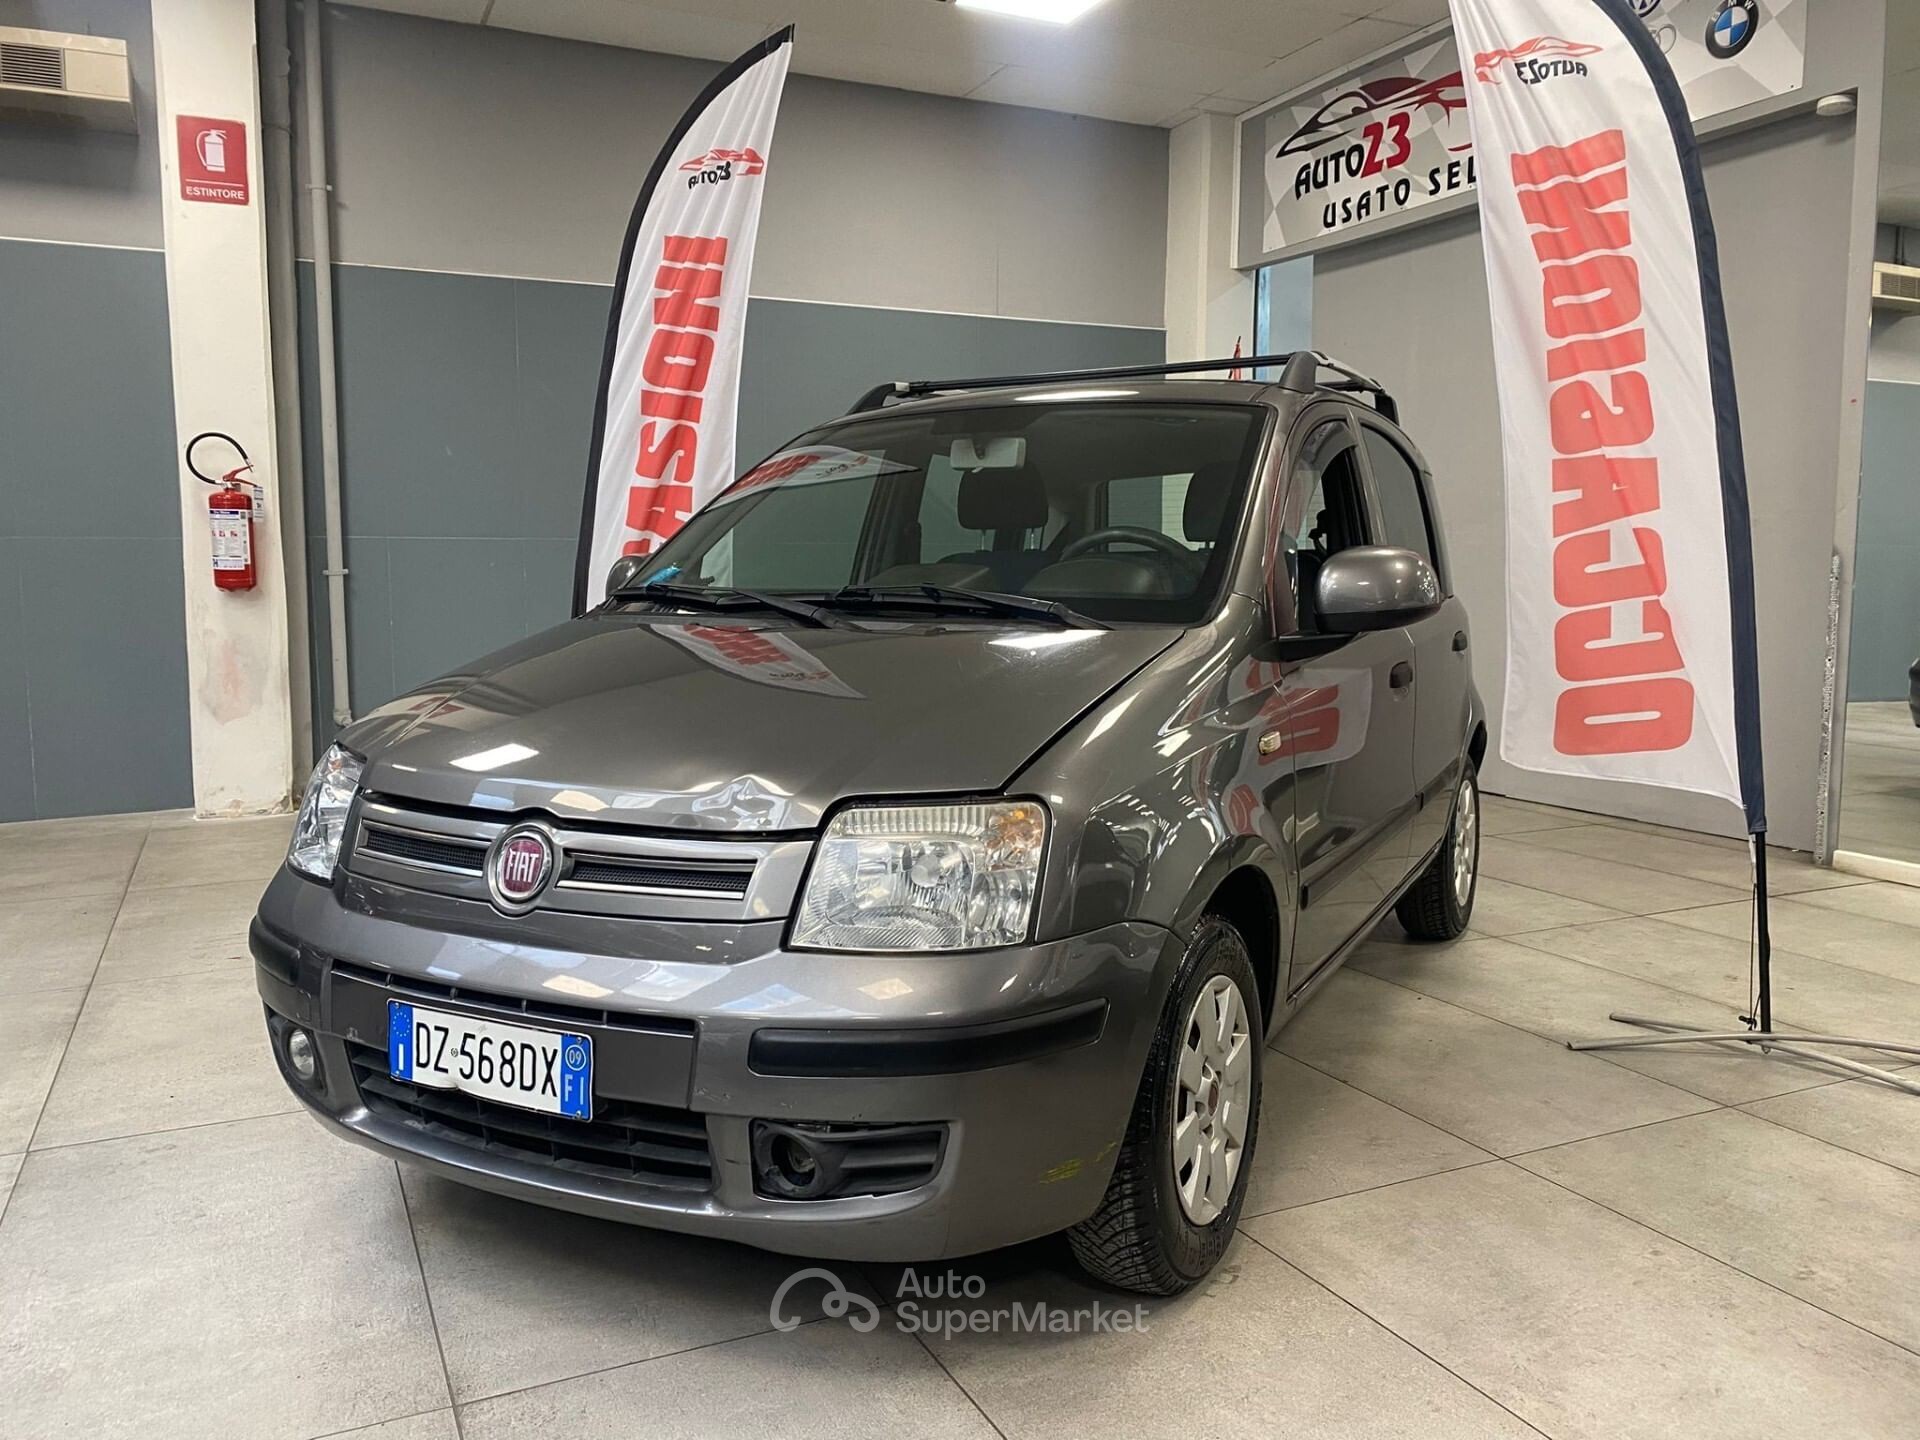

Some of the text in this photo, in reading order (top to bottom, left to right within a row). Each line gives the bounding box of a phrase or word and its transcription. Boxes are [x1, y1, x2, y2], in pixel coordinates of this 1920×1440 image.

[1295, 111, 1411, 200] AUTO23
[186, 186, 245, 199] ESTINTORE
[1323, 178, 1411, 229] USATO
[506, 848, 540, 883] FIAT
[415, 1022, 559, 1098] DZ 568DX
[568, 1048, 583, 1064] 09
